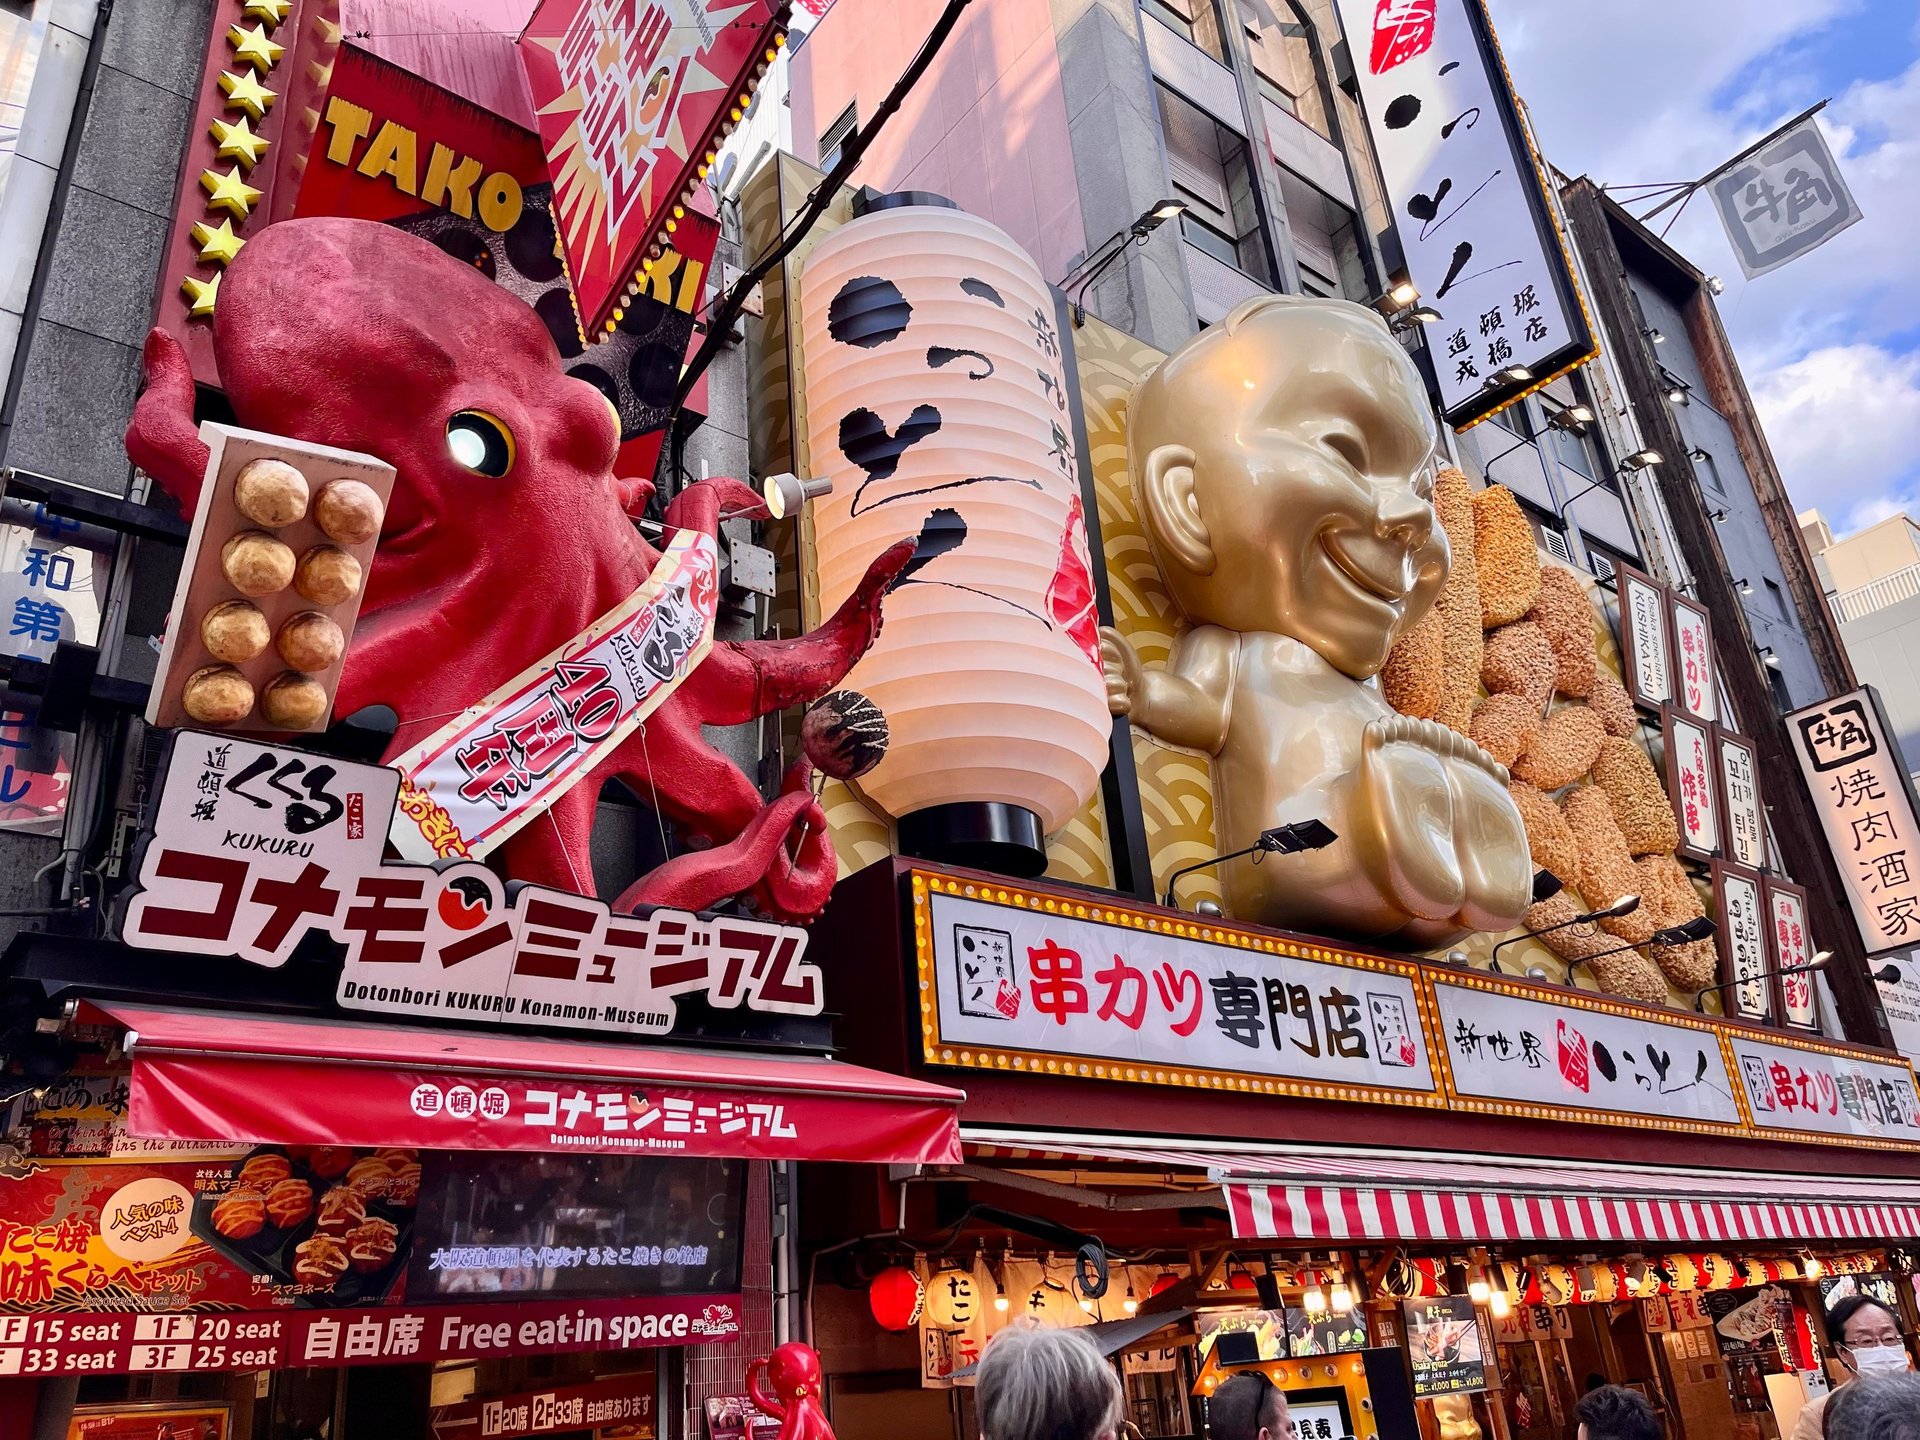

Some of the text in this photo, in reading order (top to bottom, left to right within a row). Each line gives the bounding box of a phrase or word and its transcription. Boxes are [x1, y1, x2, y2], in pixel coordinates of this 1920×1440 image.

[325, 95, 523, 232] TAKO
[1743, 167, 1833, 226] 牛角
[1446, 284, 1541, 359] 道頓堀
[1634, 589, 1654, 695] KUSHIKATSU
[1646, 594, 1665, 691] Osaka specialty
[611, 635, 647, 700] KUKURU
[1681, 626, 1702, 712] 串カツ
[1814, 719, 1868, 750] 牛角
[191, 743, 233, 822] 道頓堀
[223, 752, 345, 834] くくる
[348, 794, 363, 839] たこ家
[1727, 758, 1751, 861] 꼬치 튀김
[222, 829, 315, 858] KUKURU
[1830, 767, 1920, 937] 焼肉酒家
[138, 848, 816, 1007] コナモンミュージアム
[343, 980, 670, 1028] Dotonbori KUKURU Konamon-Museum
[1027, 938, 1371, 1059] 串カツ専門店
[1454, 1017, 1551, 1069] 新世界
[410, 1083, 510, 1120] 道頓堀
[524, 1089, 798, 1139] コナモンミュージアム
[143, 1138, 165, 1151] the
[550, 1132, 687, 1150] Dotonbori Konamon-Museum
[110, 1196, 185, 1230] 人気の味
[251, 1282, 337, 1296] ソースマヨネーズ
[947, 1276, 972, 1323] たこ
[33, 1320, 64, 1344] 15
[69, 1321, 122, 1342] seat
[152, 1317, 182, 1339] 1F
[200, 1319, 232, 1342] 20
[235, 1319, 282, 1341] seat
[304, 1314, 425, 1360] 自由席
[440, 1309, 689, 1352] Free eat-in space
[24, 1349, 60, 1373] 33
[64, 1349, 118, 1371] seat
[144, 1347, 176, 1369] 3F
[196, 1346, 227, 1369] 25
[231, 1346, 278, 1367] seat
[1412, 1360, 1431, 1371] Osaka
[586, 1394, 652, 1423] 自由席あります
